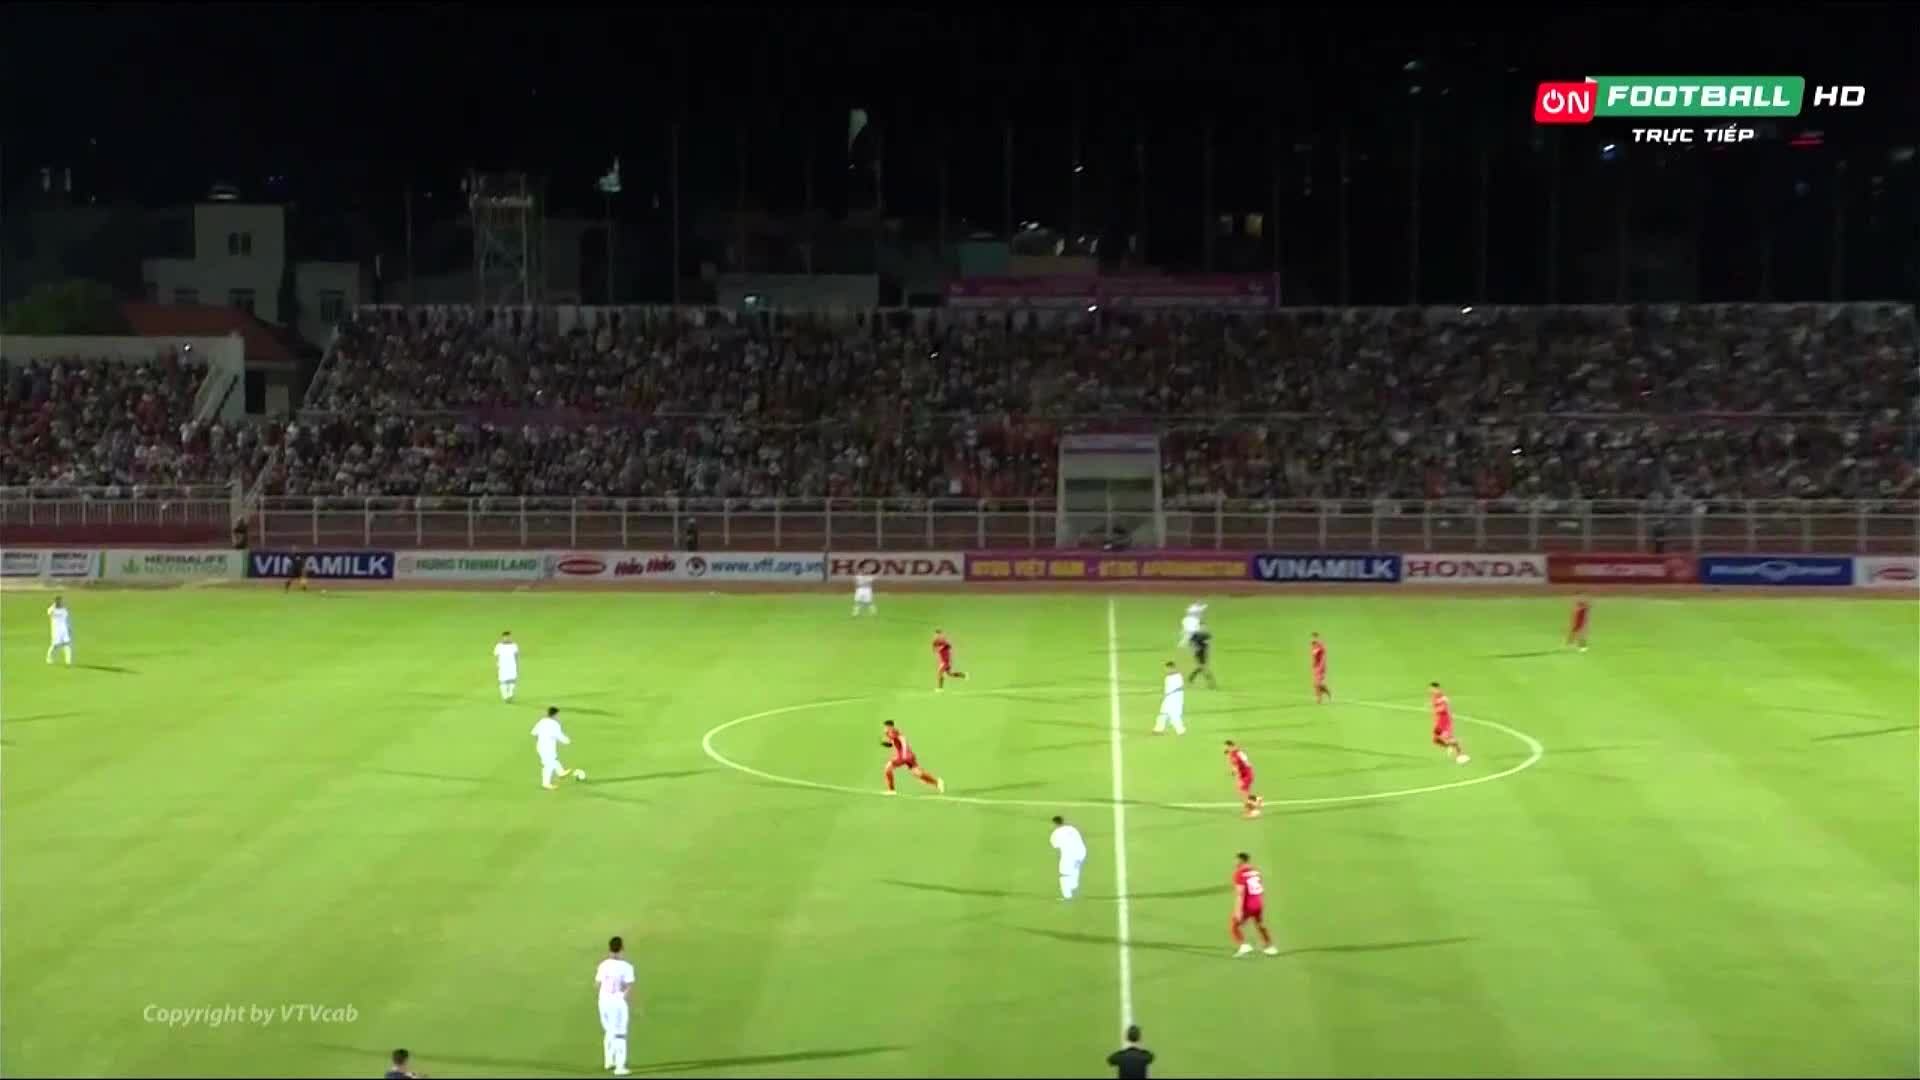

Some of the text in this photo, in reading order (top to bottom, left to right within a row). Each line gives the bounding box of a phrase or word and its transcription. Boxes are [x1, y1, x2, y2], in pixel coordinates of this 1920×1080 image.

[831, 559, 960, 575] HONDA
[1258, 558, 1394, 578] VINAMILK
[1408, 560, 1540, 577] HONDA
